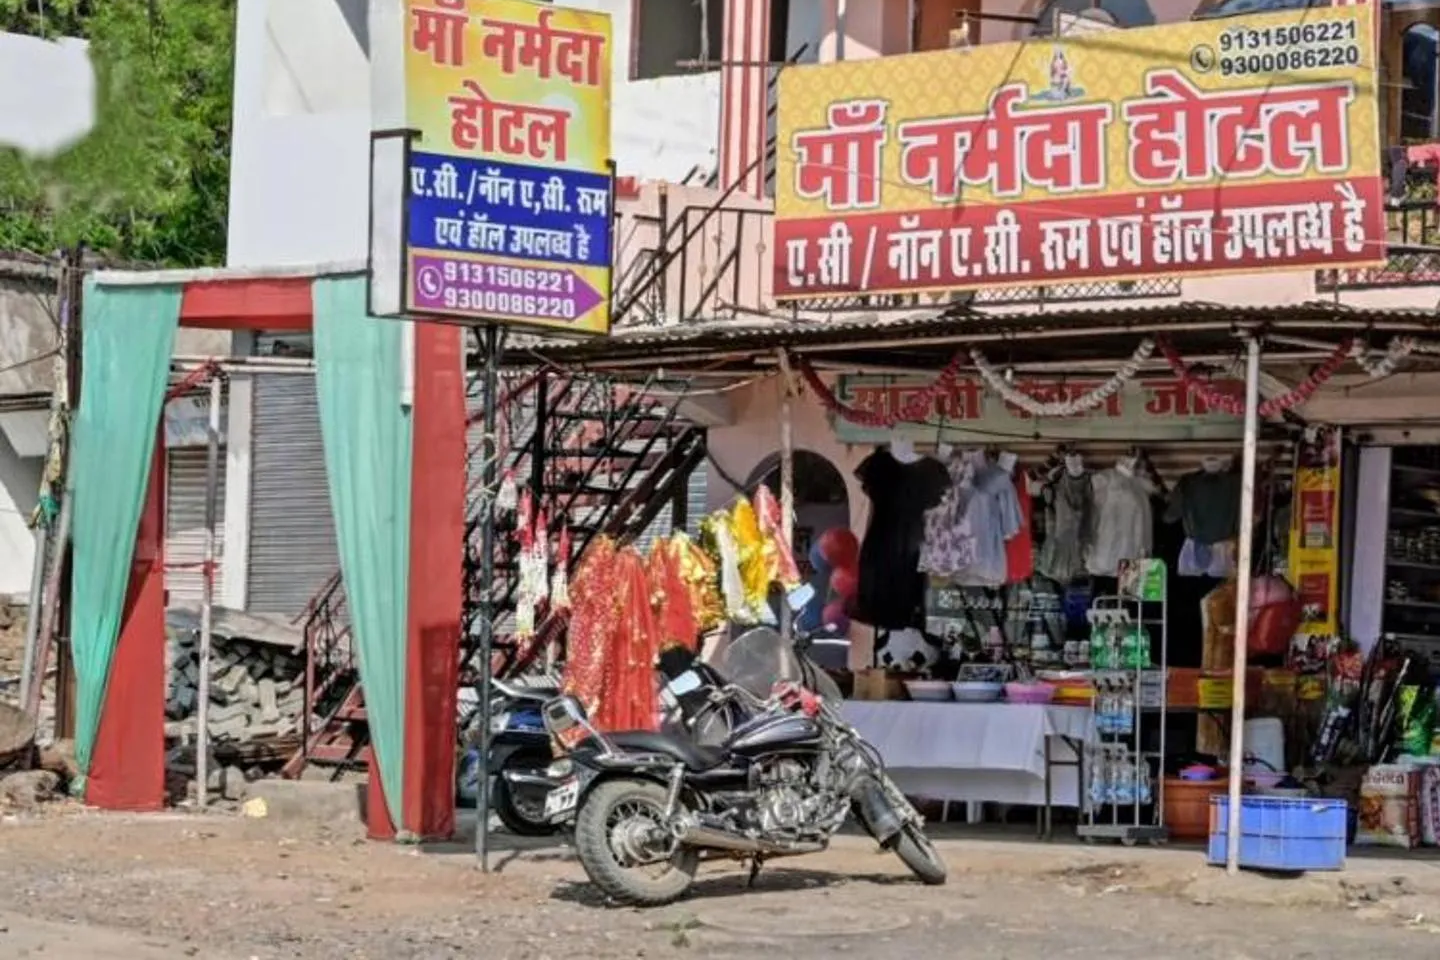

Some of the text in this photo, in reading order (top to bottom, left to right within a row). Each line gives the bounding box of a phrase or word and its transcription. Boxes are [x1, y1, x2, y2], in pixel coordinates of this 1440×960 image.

[481, 9, 606, 86] नर्मदा
[1220, 20, 1356, 50] 9131506221
[1220, 46, 1358, 75] 9300086220
[447, 80, 572, 162] होटल
[898, 84, 1112, 200] नर्मदा
[1122, 70, 1355, 185] होटल
[434, 209, 465, 246] एवं
[468, 212, 506, 252] हॉल
[509, 225, 572, 259] उपलब्ध
[887, 215, 943, 280] नॉन
[1098, 197, 1143, 267] एवं
[1151, 195, 1214, 264] हॉल
[1221, 202, 1334, 259] उपलब्ध
[1334, 181, 1366, 252] है
[443, 261, 575, 293] 9131506221
[444, 288, 575, 318] 9300086220
